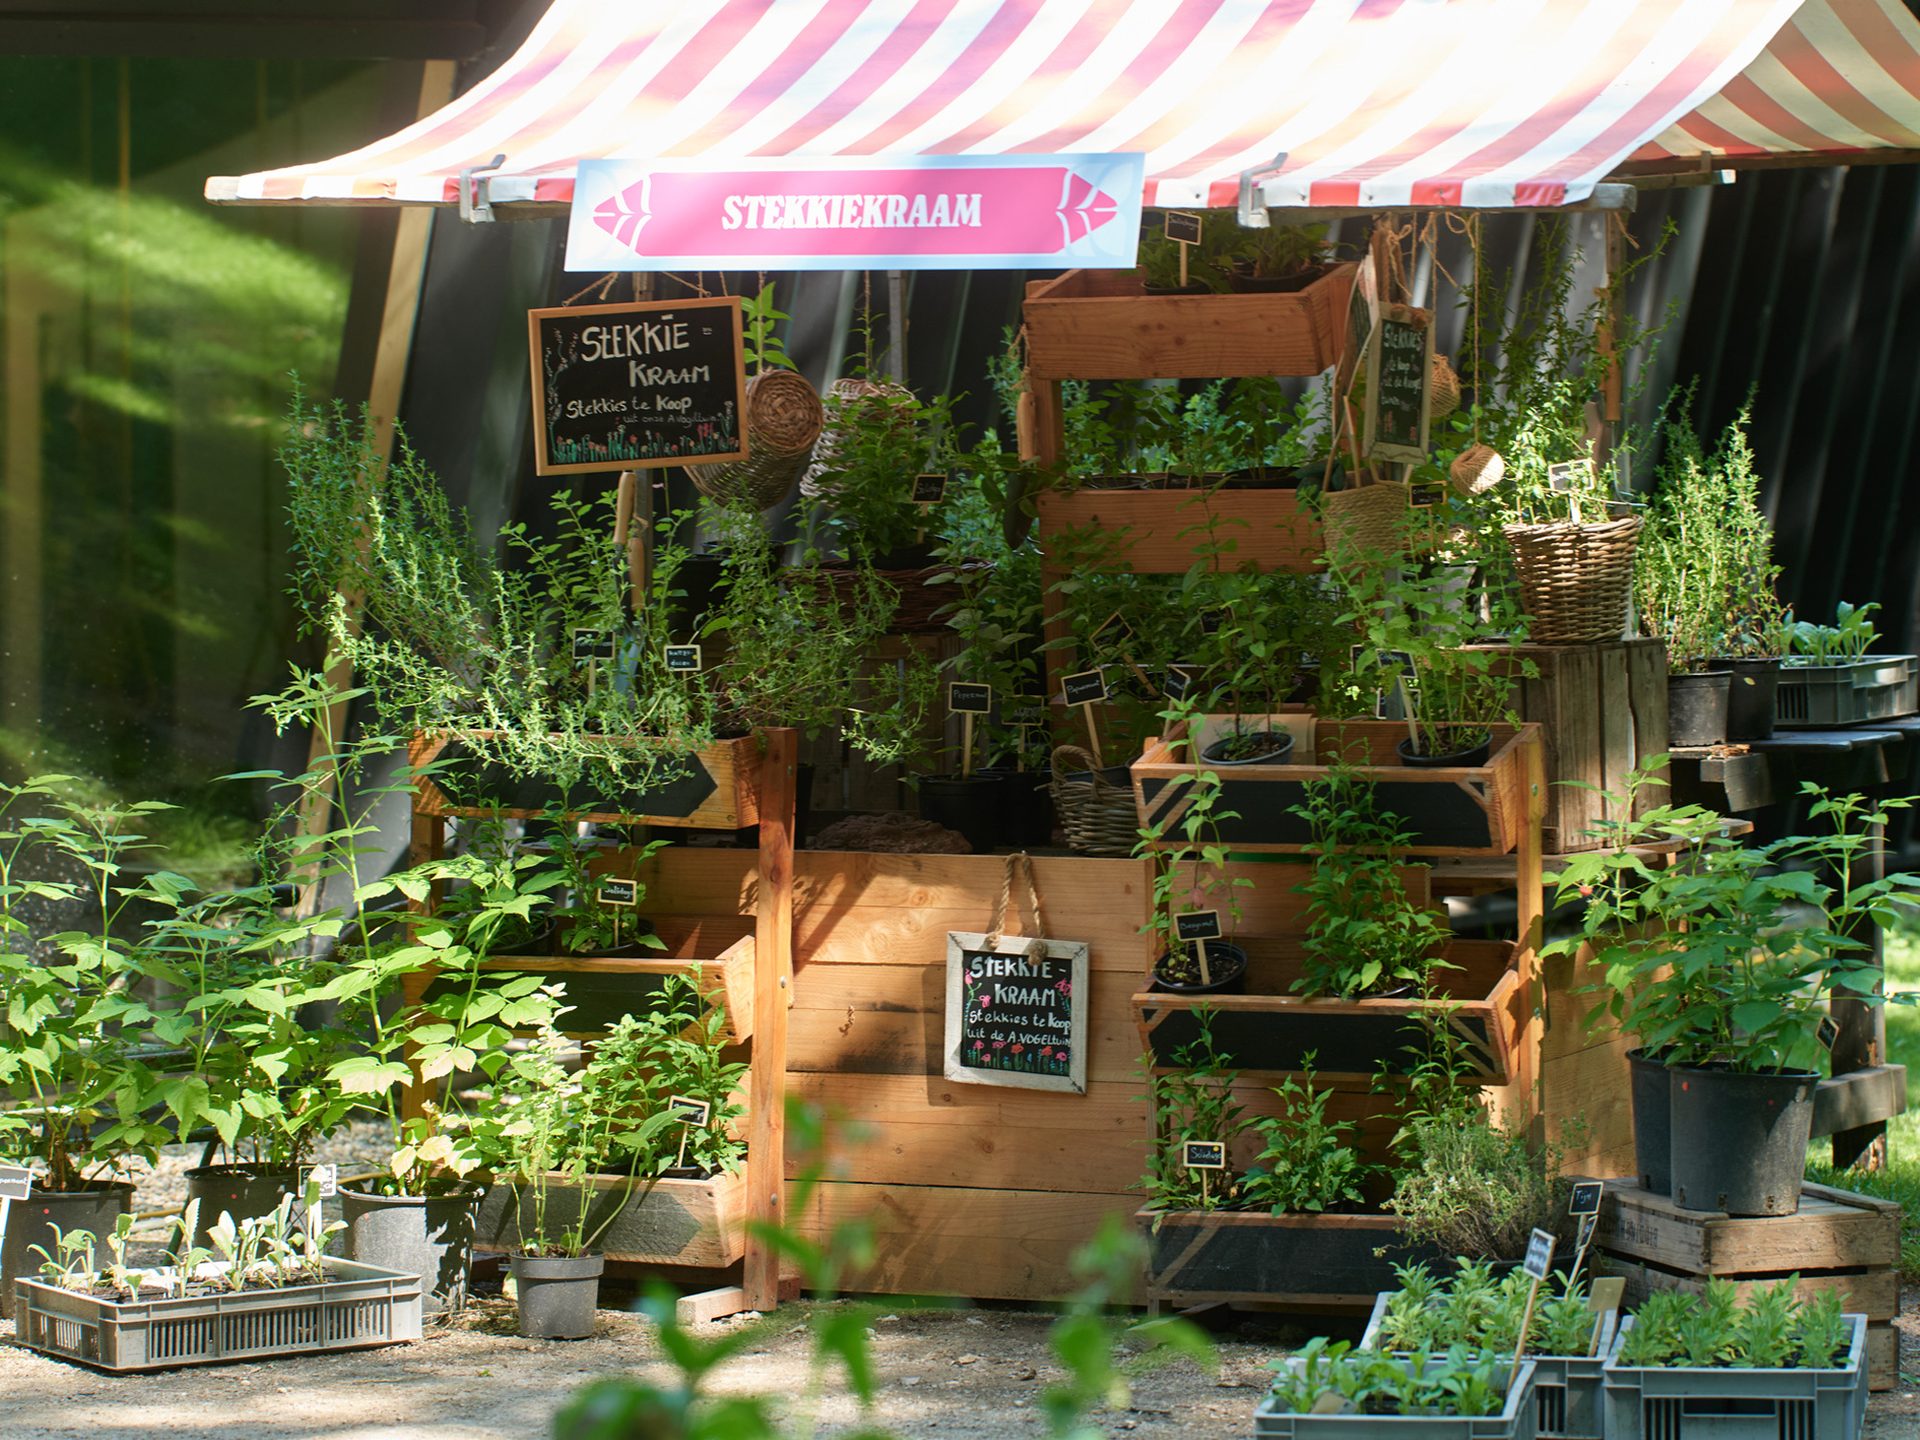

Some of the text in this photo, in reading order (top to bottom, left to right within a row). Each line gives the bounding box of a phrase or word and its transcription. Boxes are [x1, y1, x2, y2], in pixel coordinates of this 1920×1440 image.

[721, 193, 983, 231] STEKKIEKRAAM
[629, 360, 710, 388] KRAAM
[632, 396, 651, 410] te
[994, 983, 1056, 1007] KRAAM
[969, 1008, 1029, 1026] Stekkies
[1032, 1013, 1046, 1027] te
[990, 1029, 1005, 1041] de
